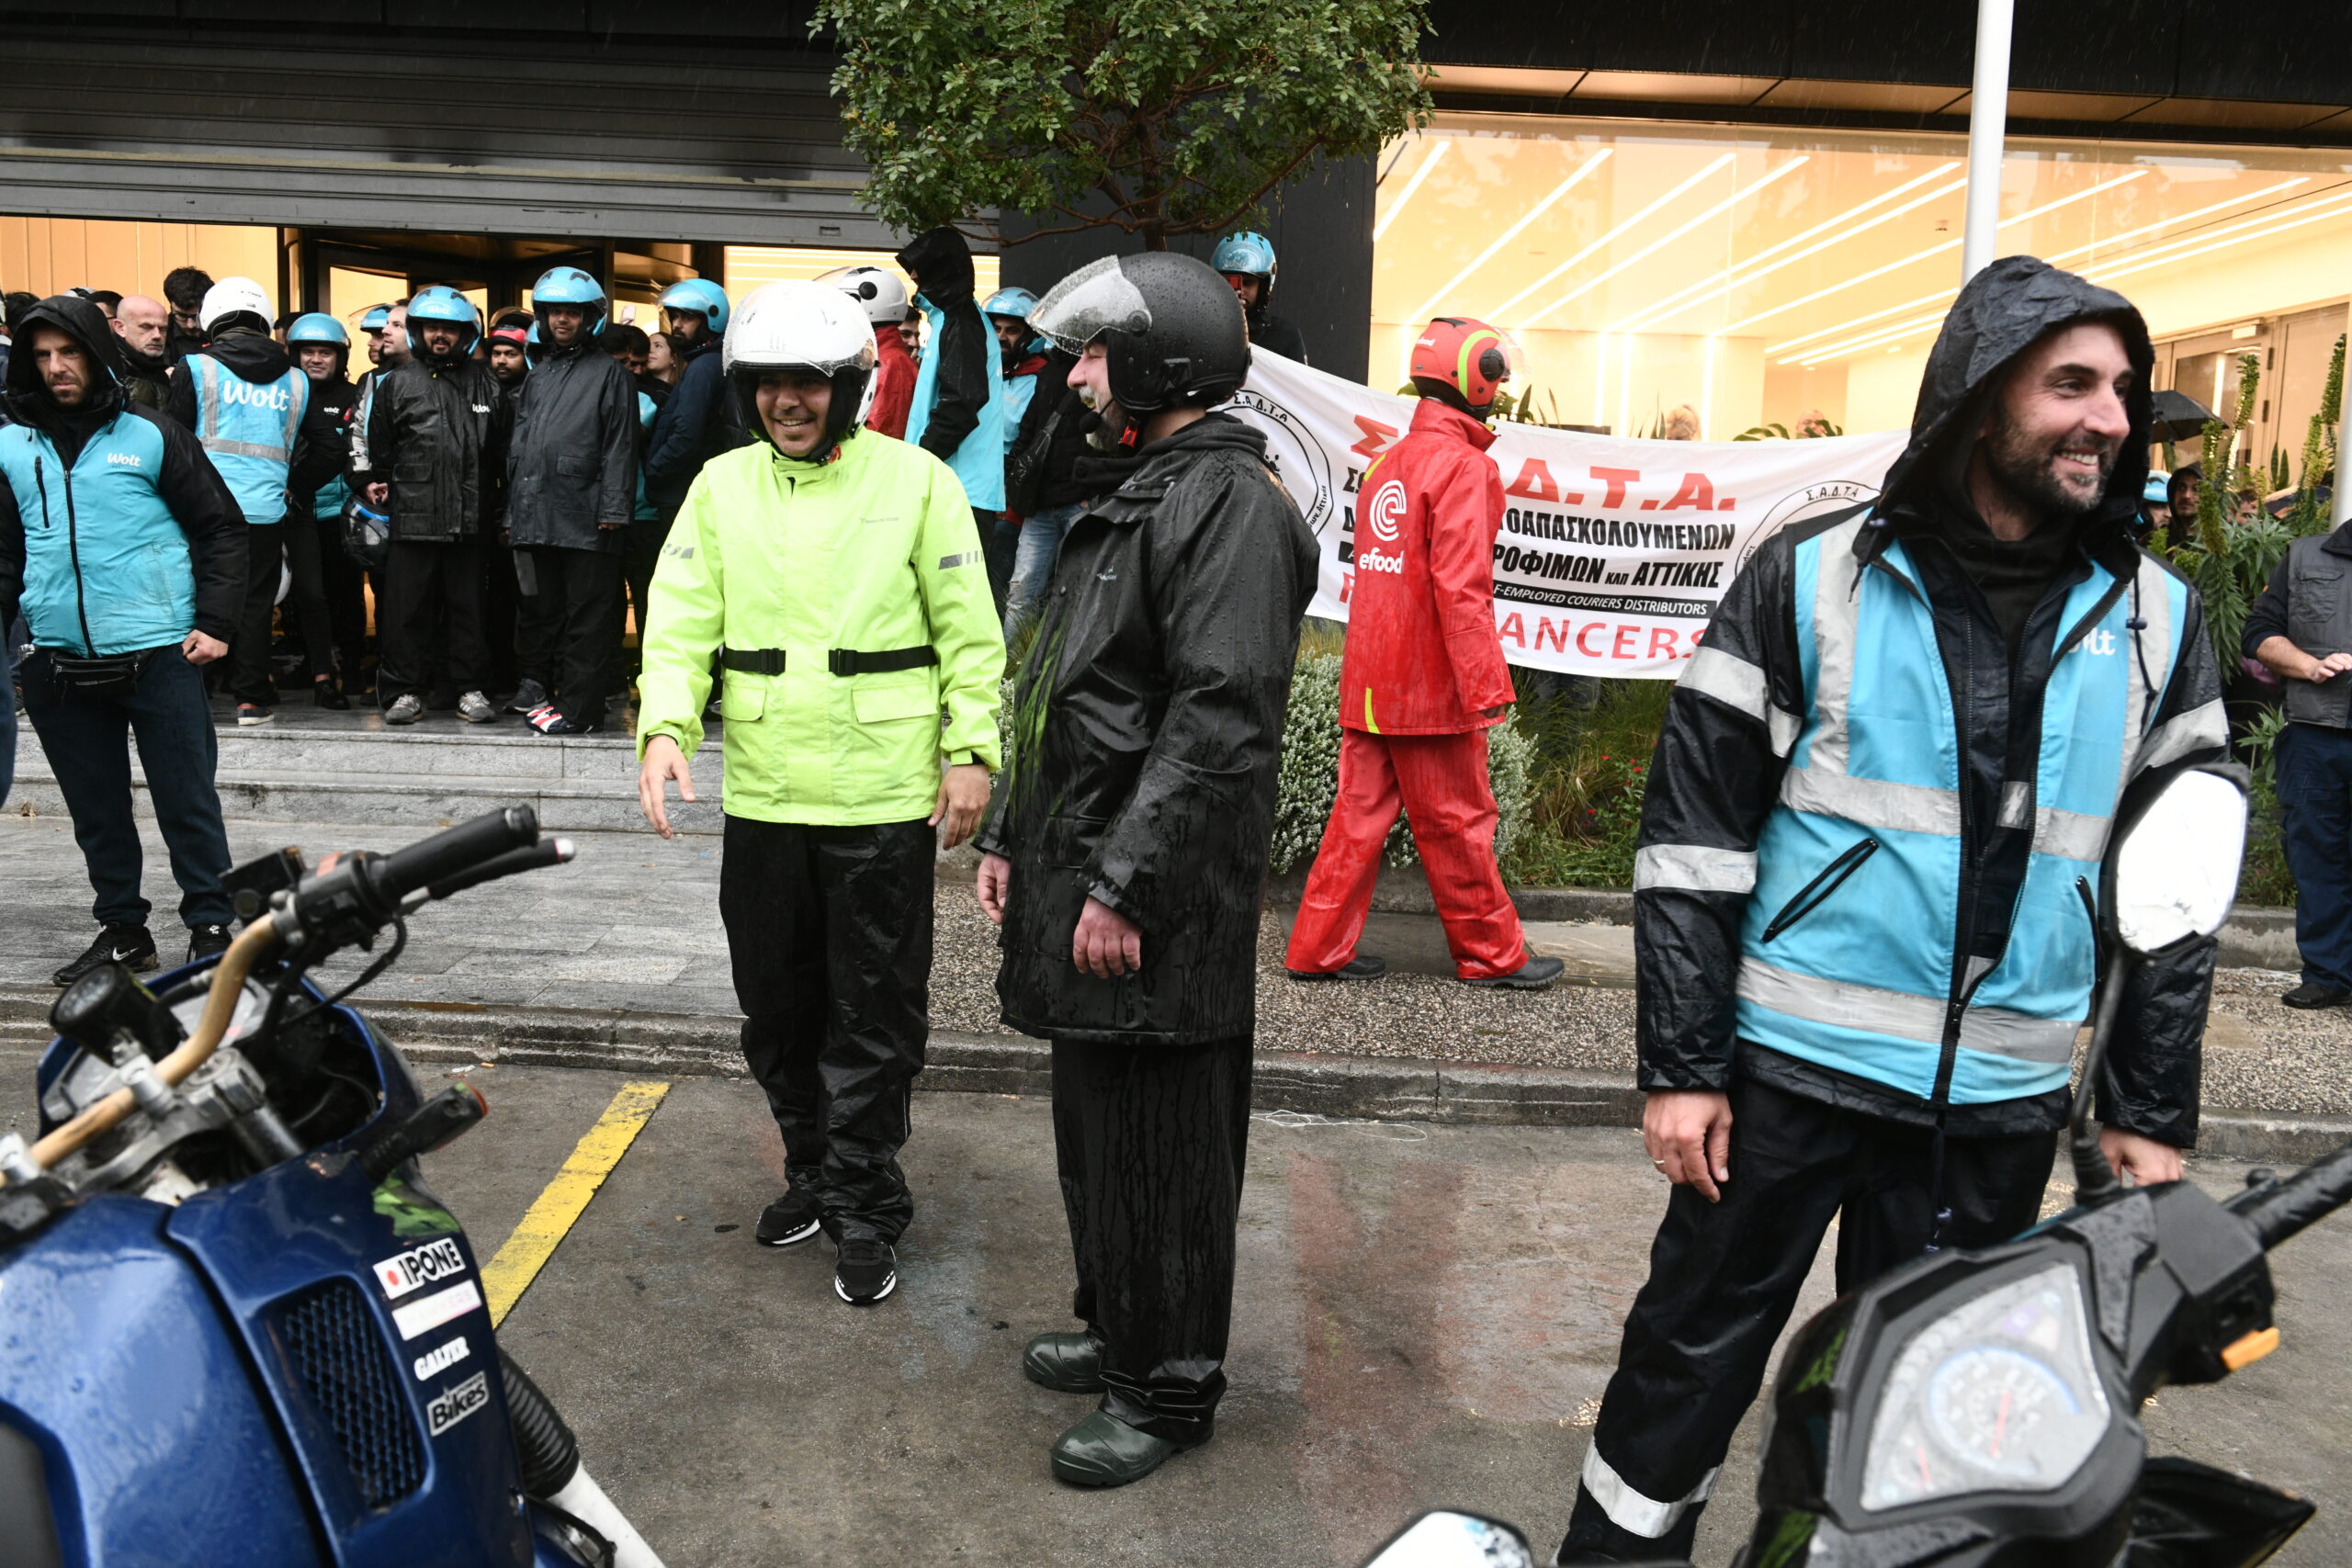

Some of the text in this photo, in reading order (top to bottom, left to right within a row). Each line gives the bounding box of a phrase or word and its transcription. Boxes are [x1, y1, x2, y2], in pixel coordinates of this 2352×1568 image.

[222, 379, 290, 412] Wolt
[107, 451, 141, 468] Wolt
[1358, 547, 1405, 574] efood
[1492, 543, 1607, 584] ΡΟΦΙΜΩΝ
[1631, 561, 1724, 589] ΑΤΤΙΚΗΣ
[1493, 585, 1708, 615] F-EMPLOYED COURIERS DISTRIBUTORS
[398, 1241, 462, 1286] IPONE
[433, 1383, 486, 1429] Bikes
